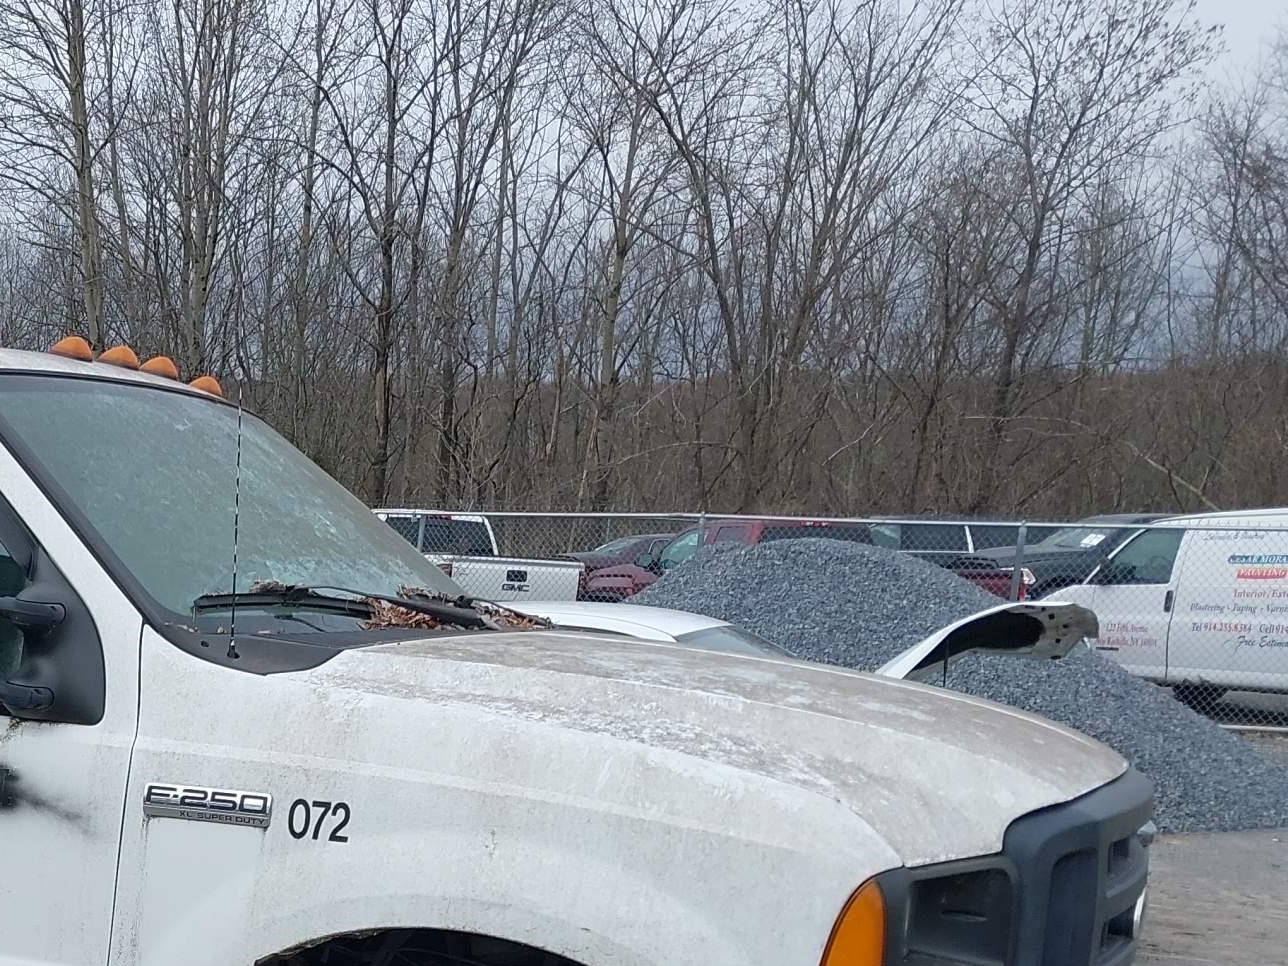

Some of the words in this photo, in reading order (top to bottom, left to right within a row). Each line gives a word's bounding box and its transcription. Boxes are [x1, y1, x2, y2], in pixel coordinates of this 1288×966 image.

[502, 583, 530, 592] GMC
[179, 810, 194, 818] XL
[196, 812, 234, 822] SUPER
[235, 815, 266, 825] DUTY
[288, 798, 351, 843] 072
